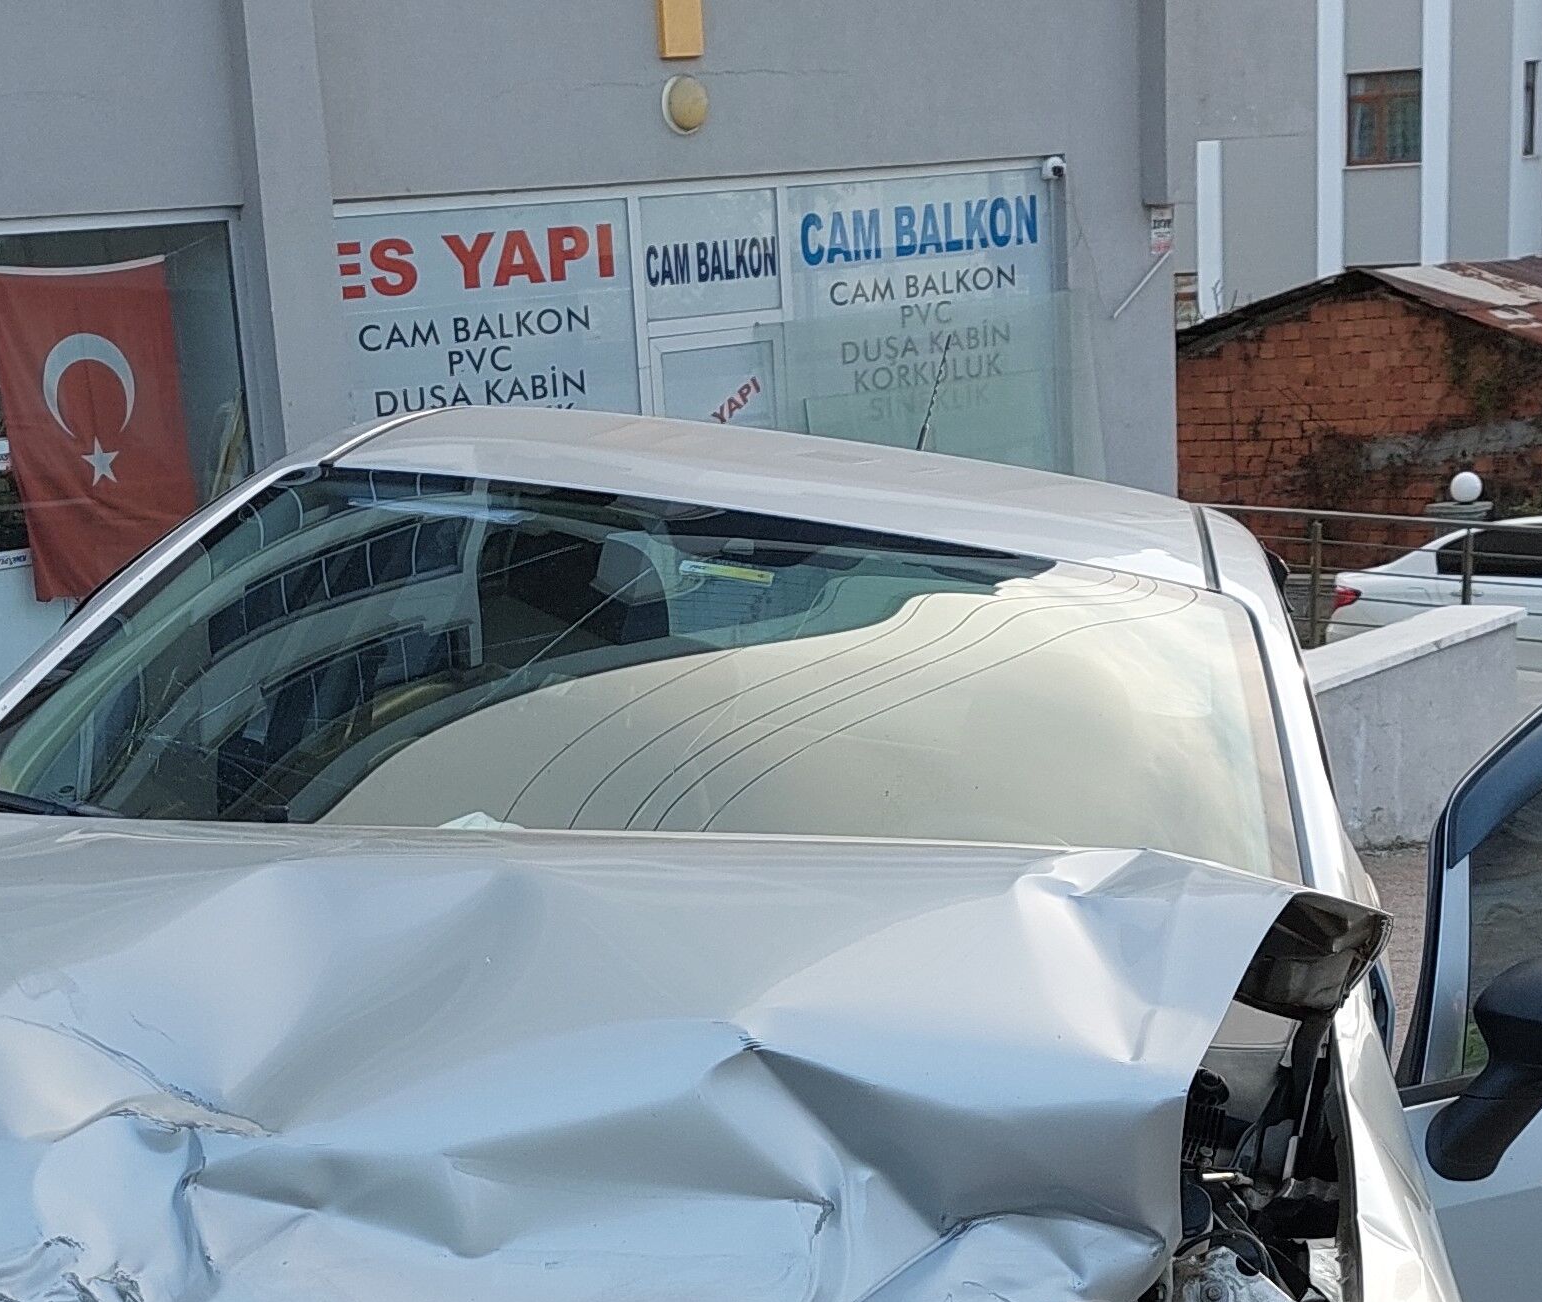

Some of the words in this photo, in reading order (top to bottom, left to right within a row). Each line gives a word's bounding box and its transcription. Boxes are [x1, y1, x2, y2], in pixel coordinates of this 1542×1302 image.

[800, 212, 882, 266] CAM
[894, 195, 1038, 258] BALKON
[441, 223, 615, 290] YAPI
[646, 243, 691, 287] CAM
[696, 236, 777, 283] BALKON
[829, 277, 895, 306] CAM
[905, 263, 1016, 299] BALKON
[359, 319, 441, 352] CAM
[453, 305, 591, 343] BALKON
[900, 300, 952, 328] PVC
[930, 319, 1010, 354] KABİN
[448, 346, 513, 377] PVC
[854, 353, 1004, 393] KORKULUK
[485, 365, 586, 406] KABİN
[711, 376, 761, 424] YAPI
